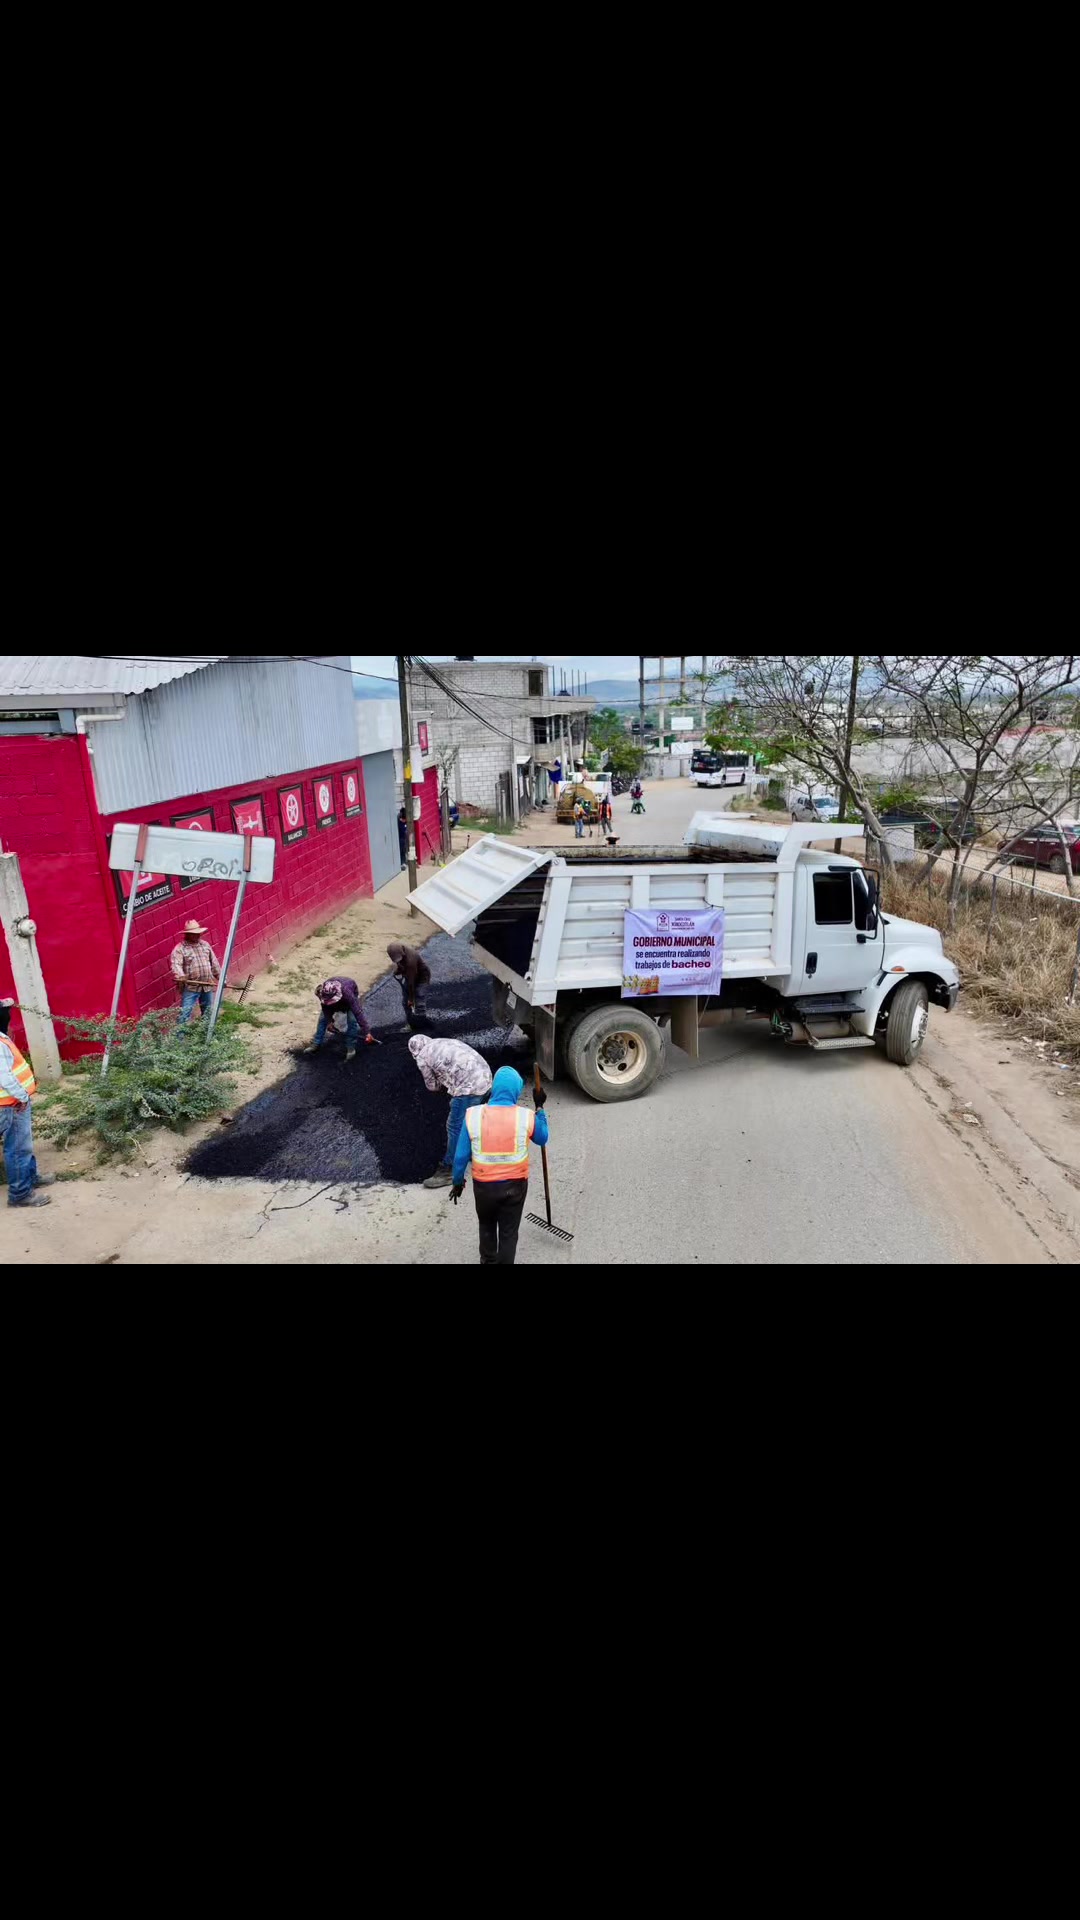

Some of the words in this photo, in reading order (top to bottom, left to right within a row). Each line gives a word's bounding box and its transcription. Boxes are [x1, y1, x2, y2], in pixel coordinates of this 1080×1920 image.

[144, 892, 153, 903] DE
[152, 885, 170, 899] ACEITE
[633, 936, 672, 947] GOBIERNO
[673, 936, 715, 947] MUNICIPAL
[645, 950, 676, 958] encuentra
[677, 949, 711, 958] realizando
[635, 961, 661, 970] trabajos
[671, 960, 711, 968] bacheo
